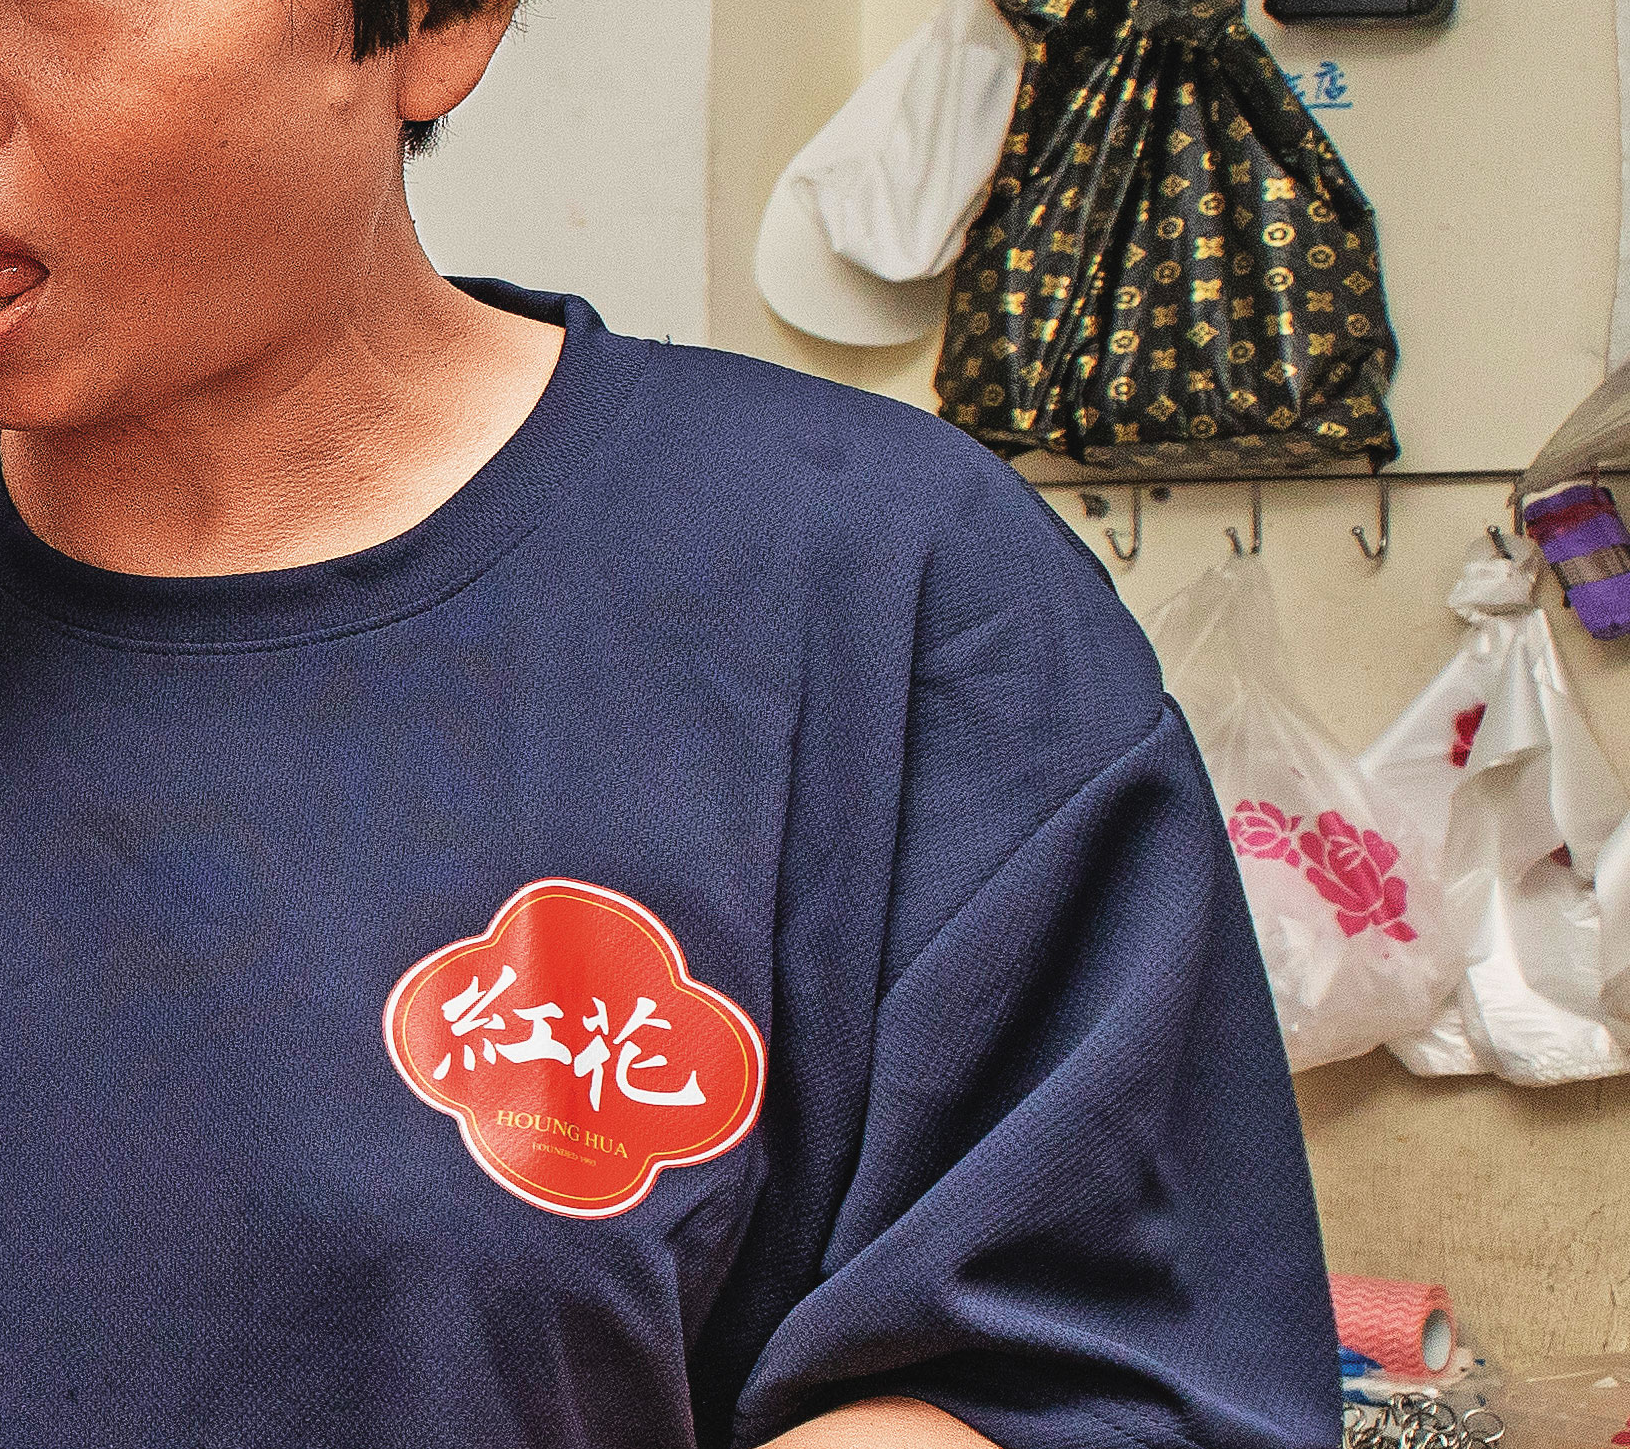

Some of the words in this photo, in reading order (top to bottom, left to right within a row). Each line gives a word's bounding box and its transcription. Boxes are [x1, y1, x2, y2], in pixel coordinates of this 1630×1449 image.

[431, 964, 707, 1113] 紅花
[496, 1109, 581, 1142] HOUNG
[584, 1131, 629, 1159] HUA
